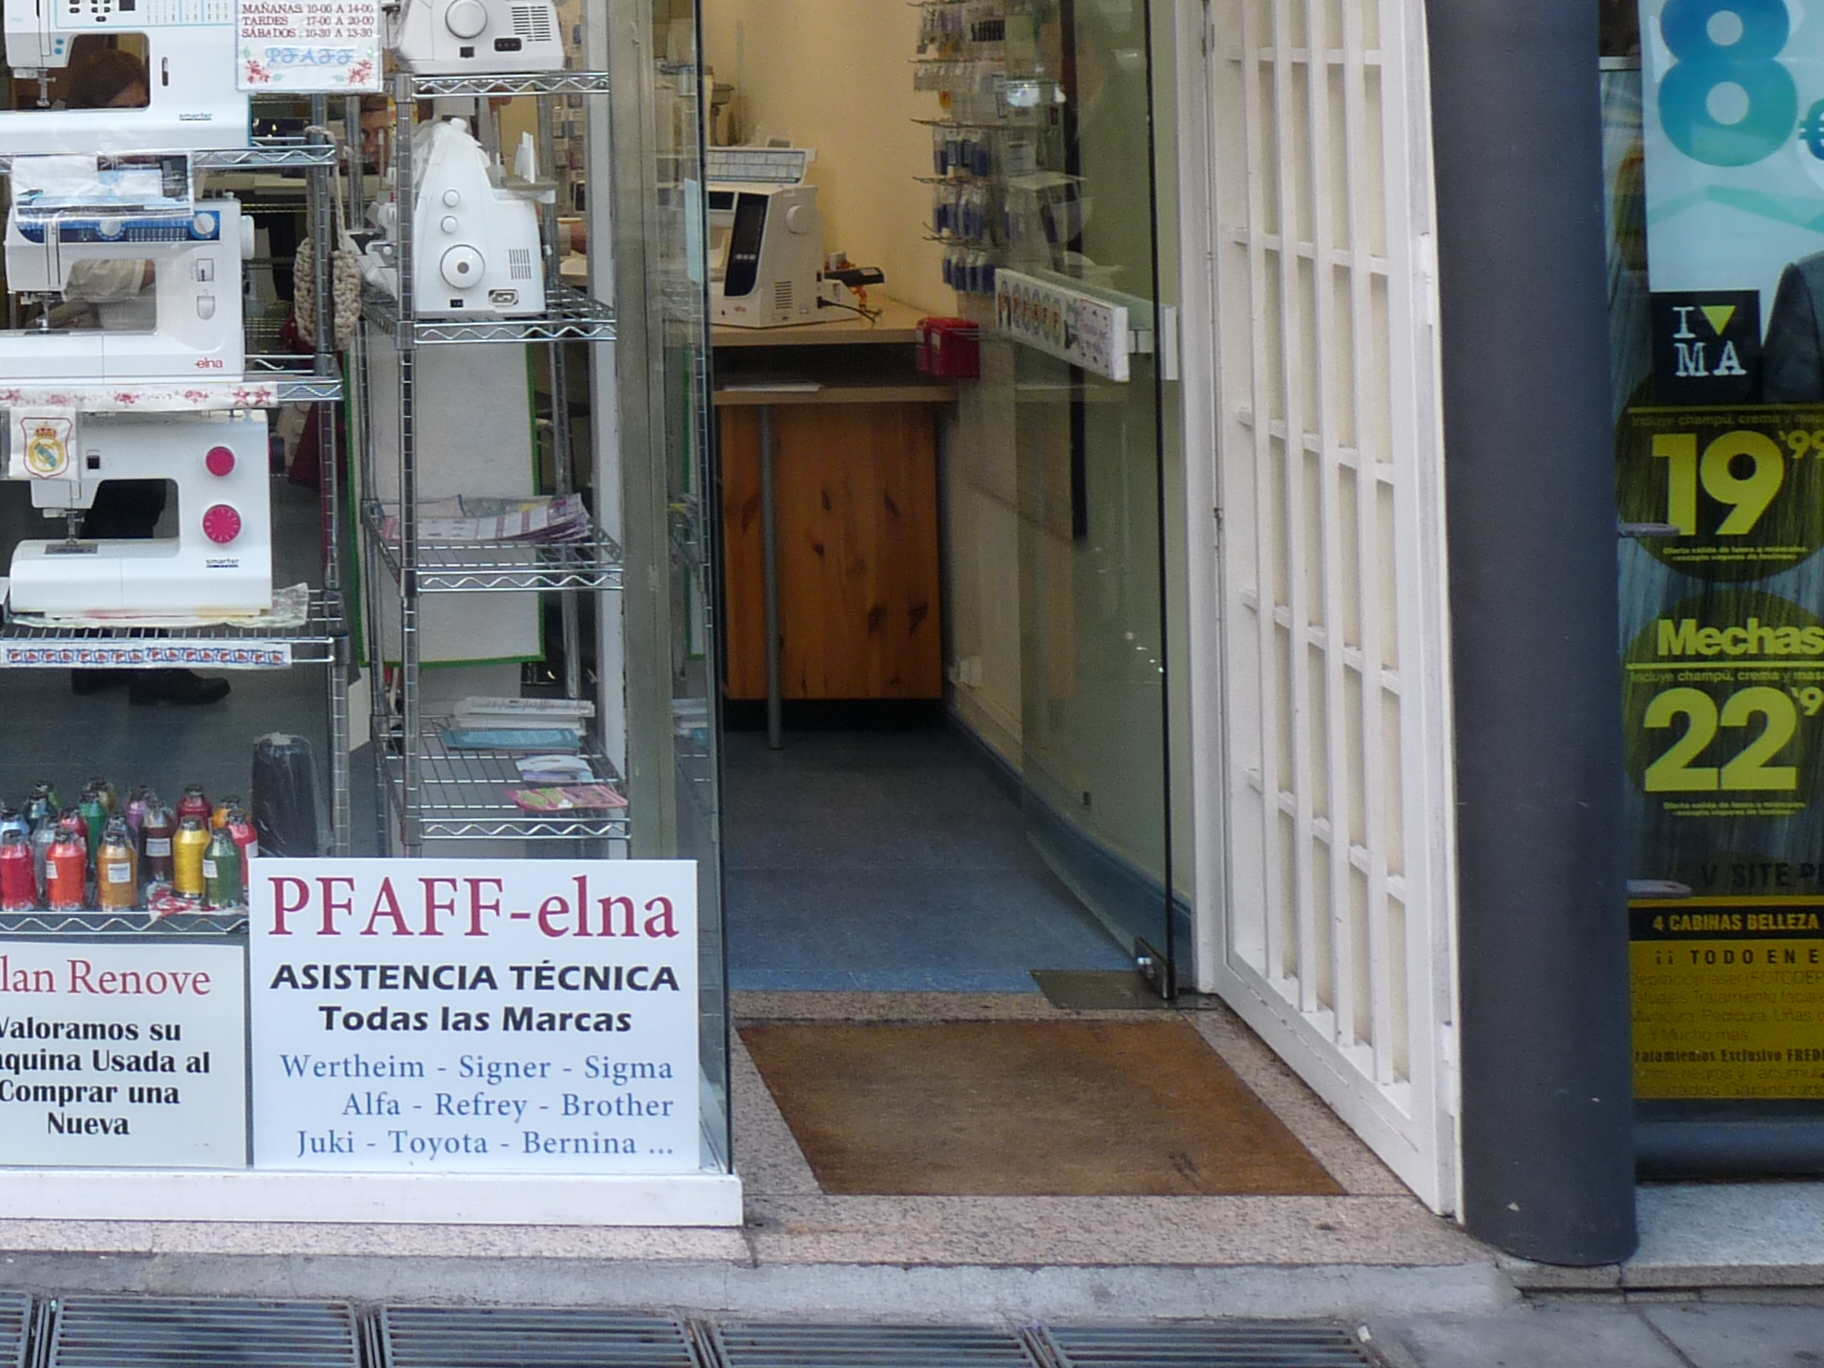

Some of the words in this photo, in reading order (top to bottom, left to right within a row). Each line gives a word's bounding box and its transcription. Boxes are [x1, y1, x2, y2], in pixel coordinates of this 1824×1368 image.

[242, 16, 288, 26] TARDES
[336, 16, 344, 26] A
[348, 16, 374, 26] 20-00
[307, 3, 332, 14] 10-00
[336, 3, 344, 14] A
[348, 3, 373, 14] 14-00
[242, 27, 296, 38] SÁBADOS
[306, 28, 330, 38] 10-30
[335, 28, 343, 38] A
[265, 47, 355, 66] PFAFF
[195, 357, 223, 368] elna
[1644, 686, 1797, 792] 22
[268, 876, 680, 939] PFAFF-elna
[1652, 914, 1665, 932] 4
[1669, 913, 1742, 932] CABINAS
[1747, 912, 1820, 931] BELLEZA
[1690, 948, 1755, 965] TODO
[1768, 947, 1796, 965] EN
[67, 957, 212, 995] Renove
[270, 964, 498, 991] ASISTENCIA
[509, 958, 680, 991] TÉCNICA
[319, 1004, 429, 1032] Todas
[439, 1004, 489, 1032] las
[501, 1004, 632, 1032] Marcas
[147, 1022, 182, 1042] su
[91, 1048, 176, 1074] Usada
[185, 1050, 210, 1074] al
[280, 1053, 426, 1079] Wertheim
[458, 1053, 552, 1086] Signer
[583, 1053, 674, 1086] Sigma
[127, 1084, 181, 1105] una
[342, 1091, 402, 1116] Alfa
[434, 1091, 528, 1125] Refrey
[561, 1091, 675, 1117] Brother
[46, 1110, 131, 1136] Nueva
[295, 1128, 356, 1159] Juki
[388, 1128, 489, 1160] Toyota
[522, 1128, 638, 1155] Bernina
